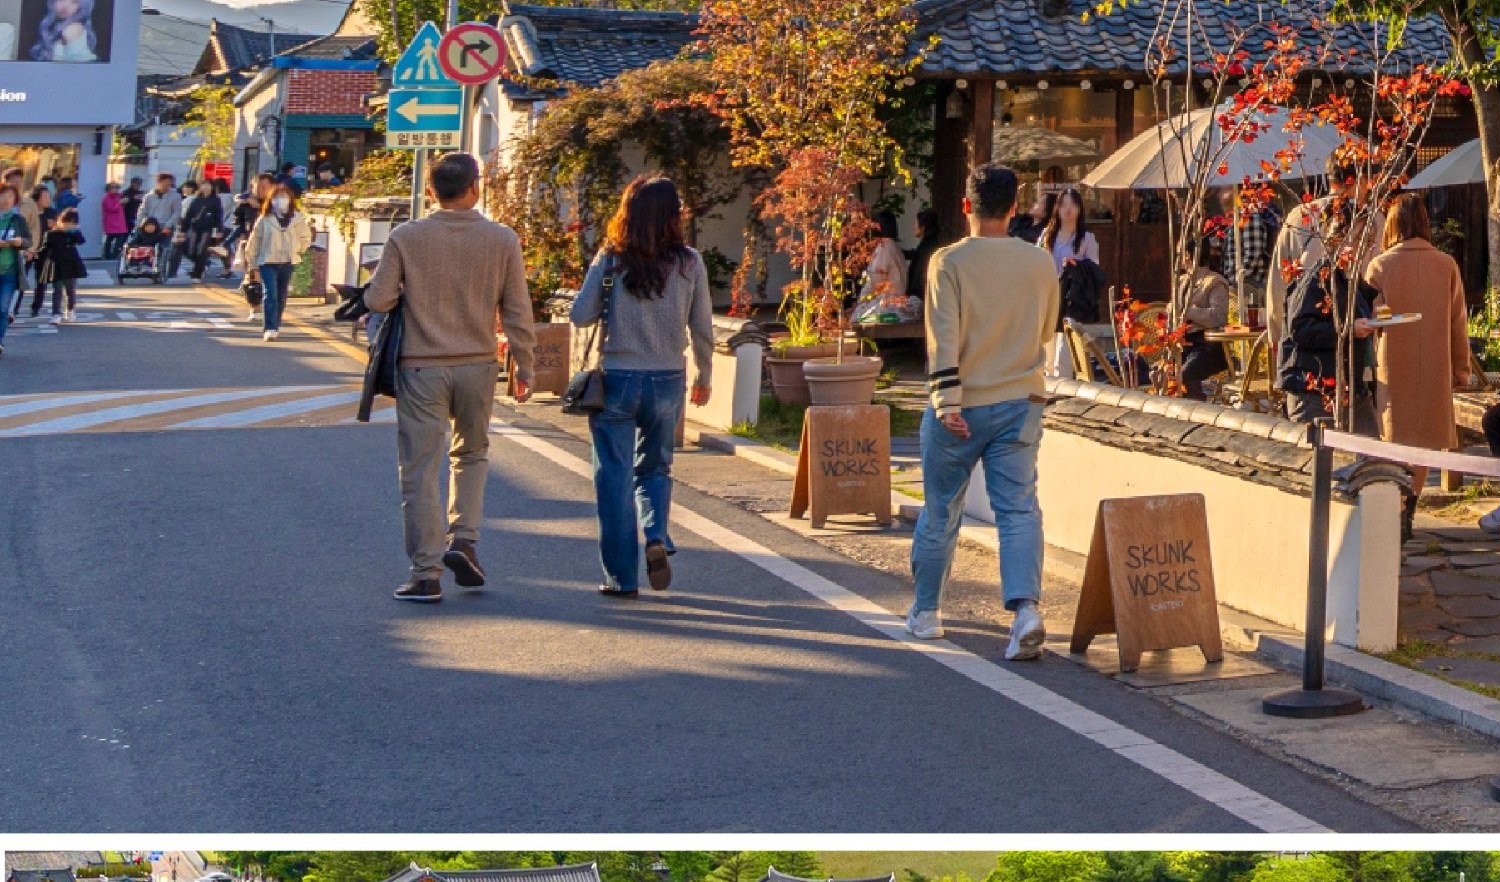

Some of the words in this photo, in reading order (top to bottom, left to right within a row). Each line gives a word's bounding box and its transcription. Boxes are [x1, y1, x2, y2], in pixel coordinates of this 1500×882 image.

[0, 88, 27, 102] ion
[397, 132, 453, 146] 일방통행
[821, 438, 878, 457] SKUNK
[821, 459, 880, 477] WORKS
[1125, 540, 1196, 569] SKUNK
[1127, 569, 1200, 597] WORKS
